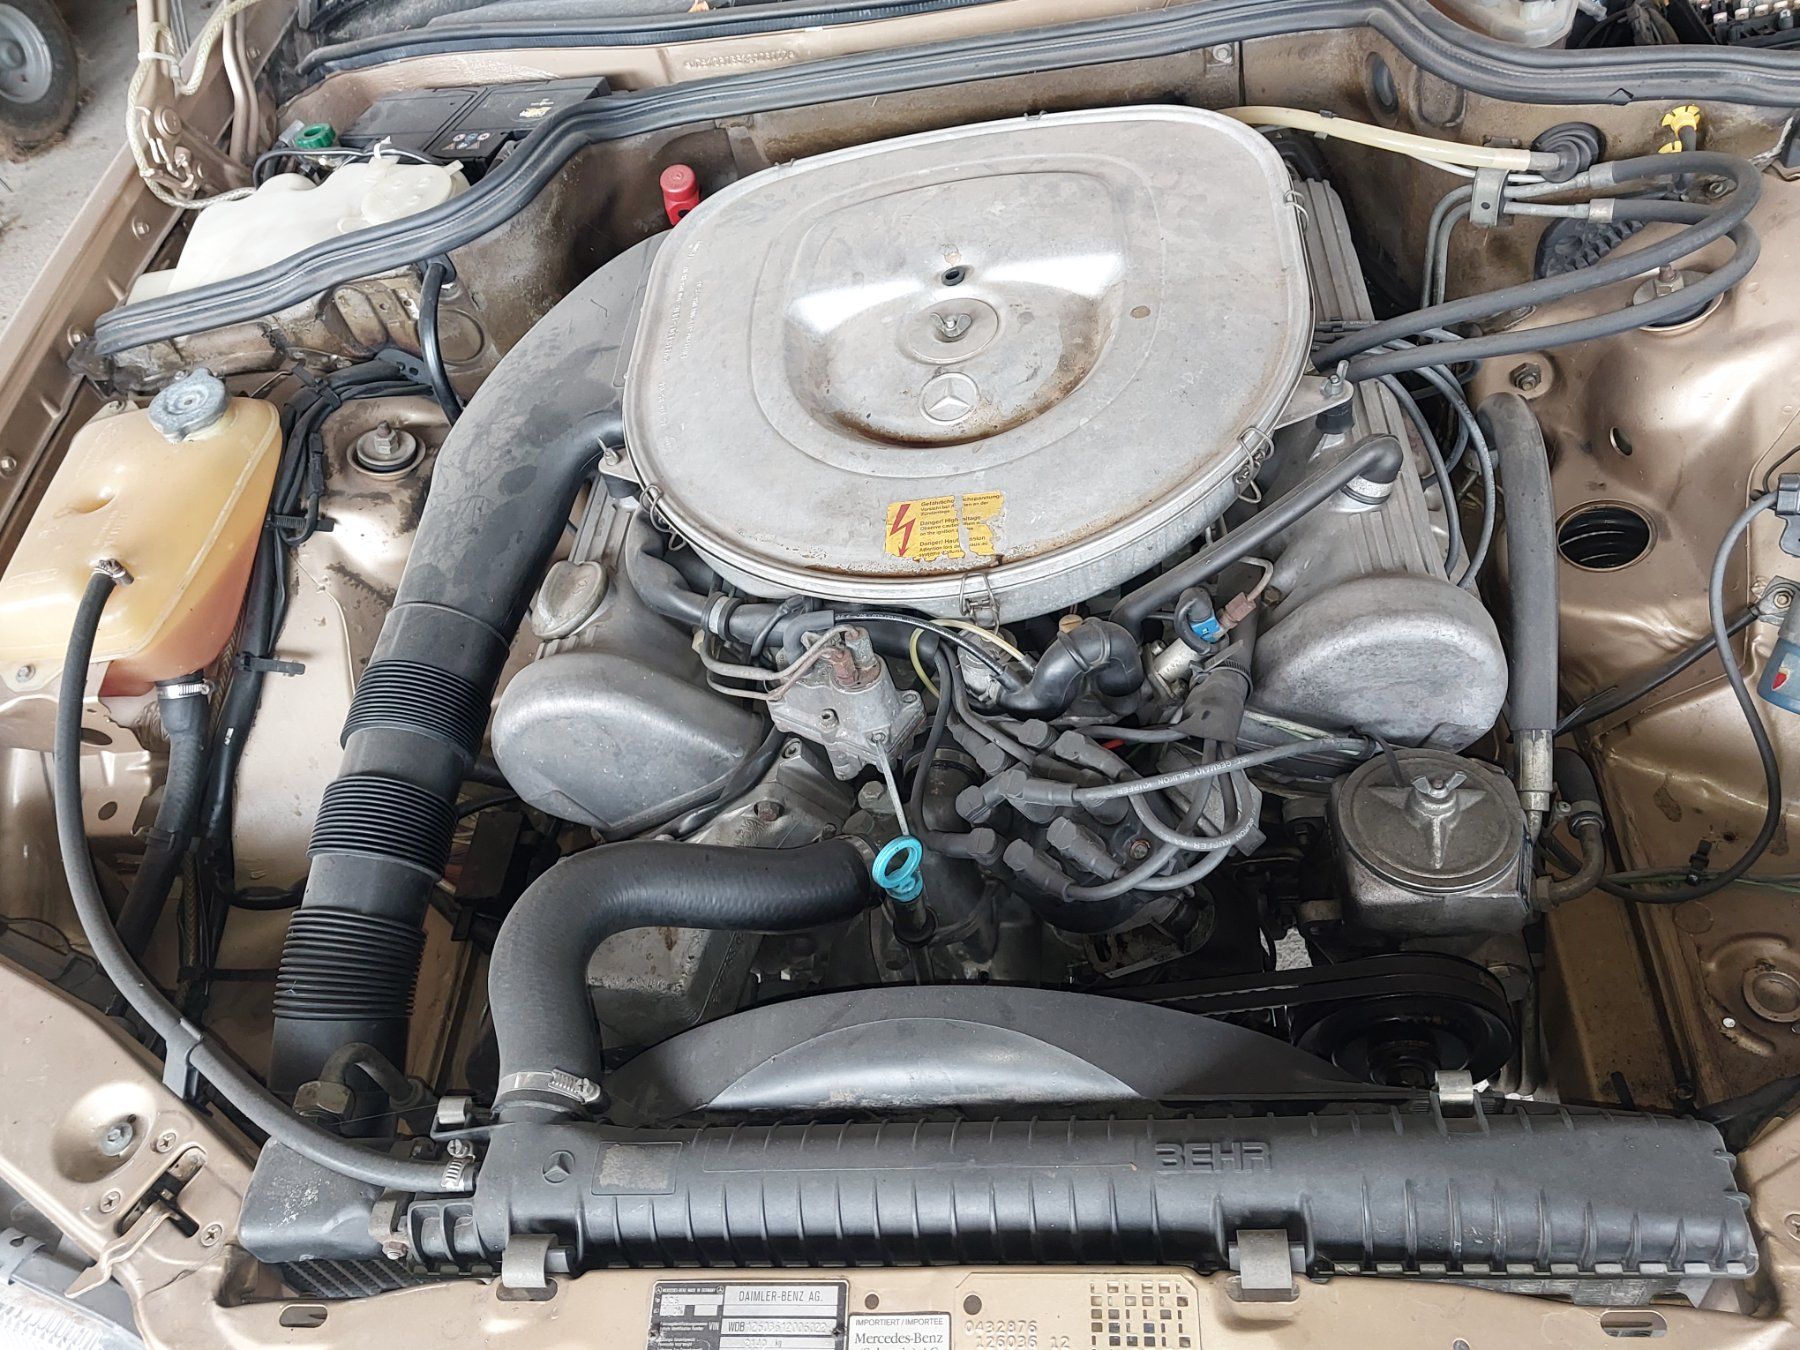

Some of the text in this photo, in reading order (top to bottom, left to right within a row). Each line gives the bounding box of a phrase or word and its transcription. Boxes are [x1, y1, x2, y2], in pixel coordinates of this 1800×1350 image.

[1155, 1139, 1271, 1174] BEHR
[738, 1290, 804, 1302] DAIMLER-BENZ
[854, 1332, 944, 1344] Mercedes-Benz
